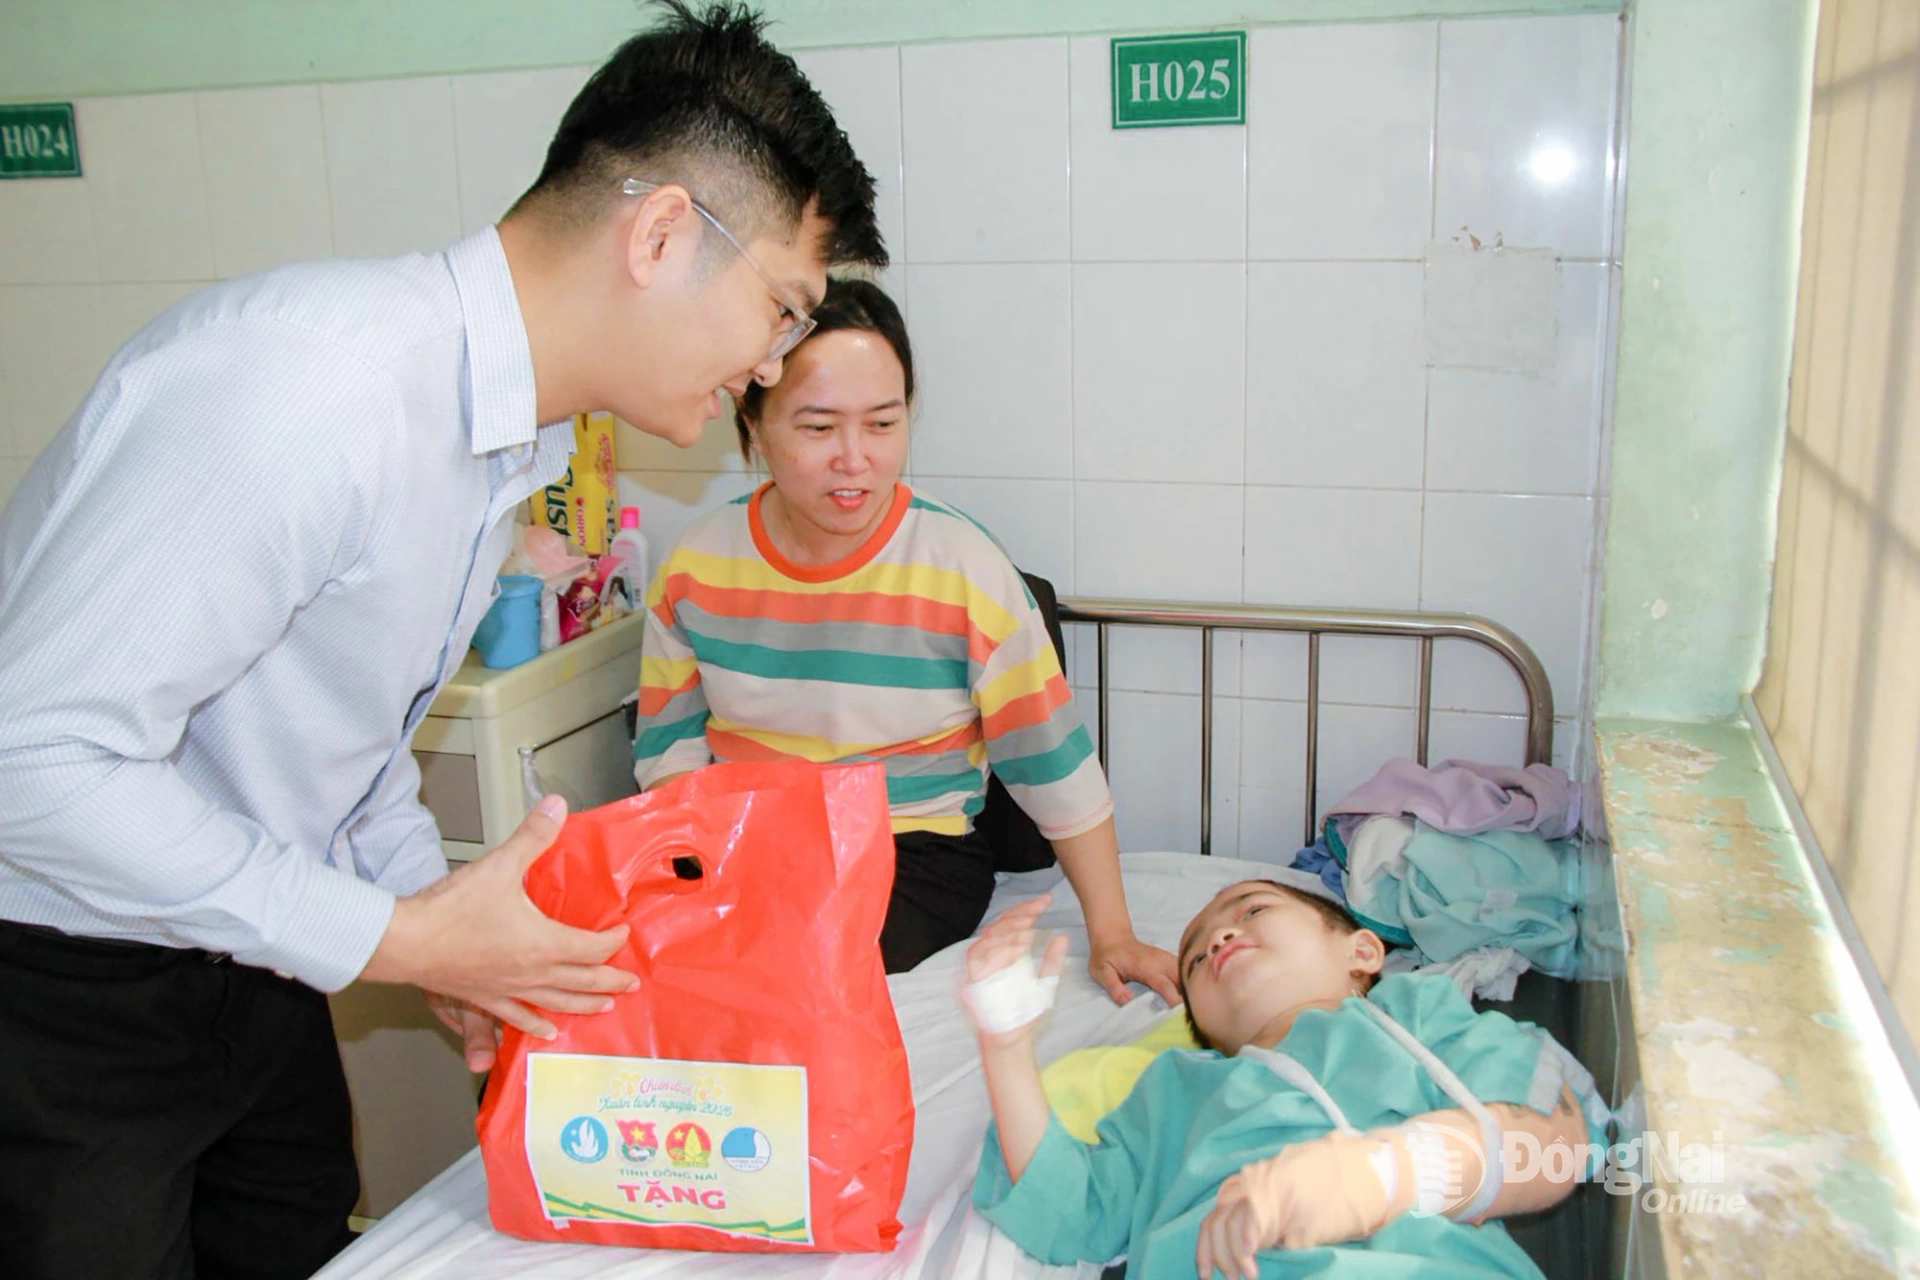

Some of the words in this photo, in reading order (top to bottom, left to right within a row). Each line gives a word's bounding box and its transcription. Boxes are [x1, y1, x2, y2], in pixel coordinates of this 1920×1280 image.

[1128, 59, 1231, 102] H025
[1, 124, 69, 157] H024
[576, 509, 587, 547] ORION
[694, 1172, 718, 1181] NAI
[617, 1180, 726, 1209] TẶNG
